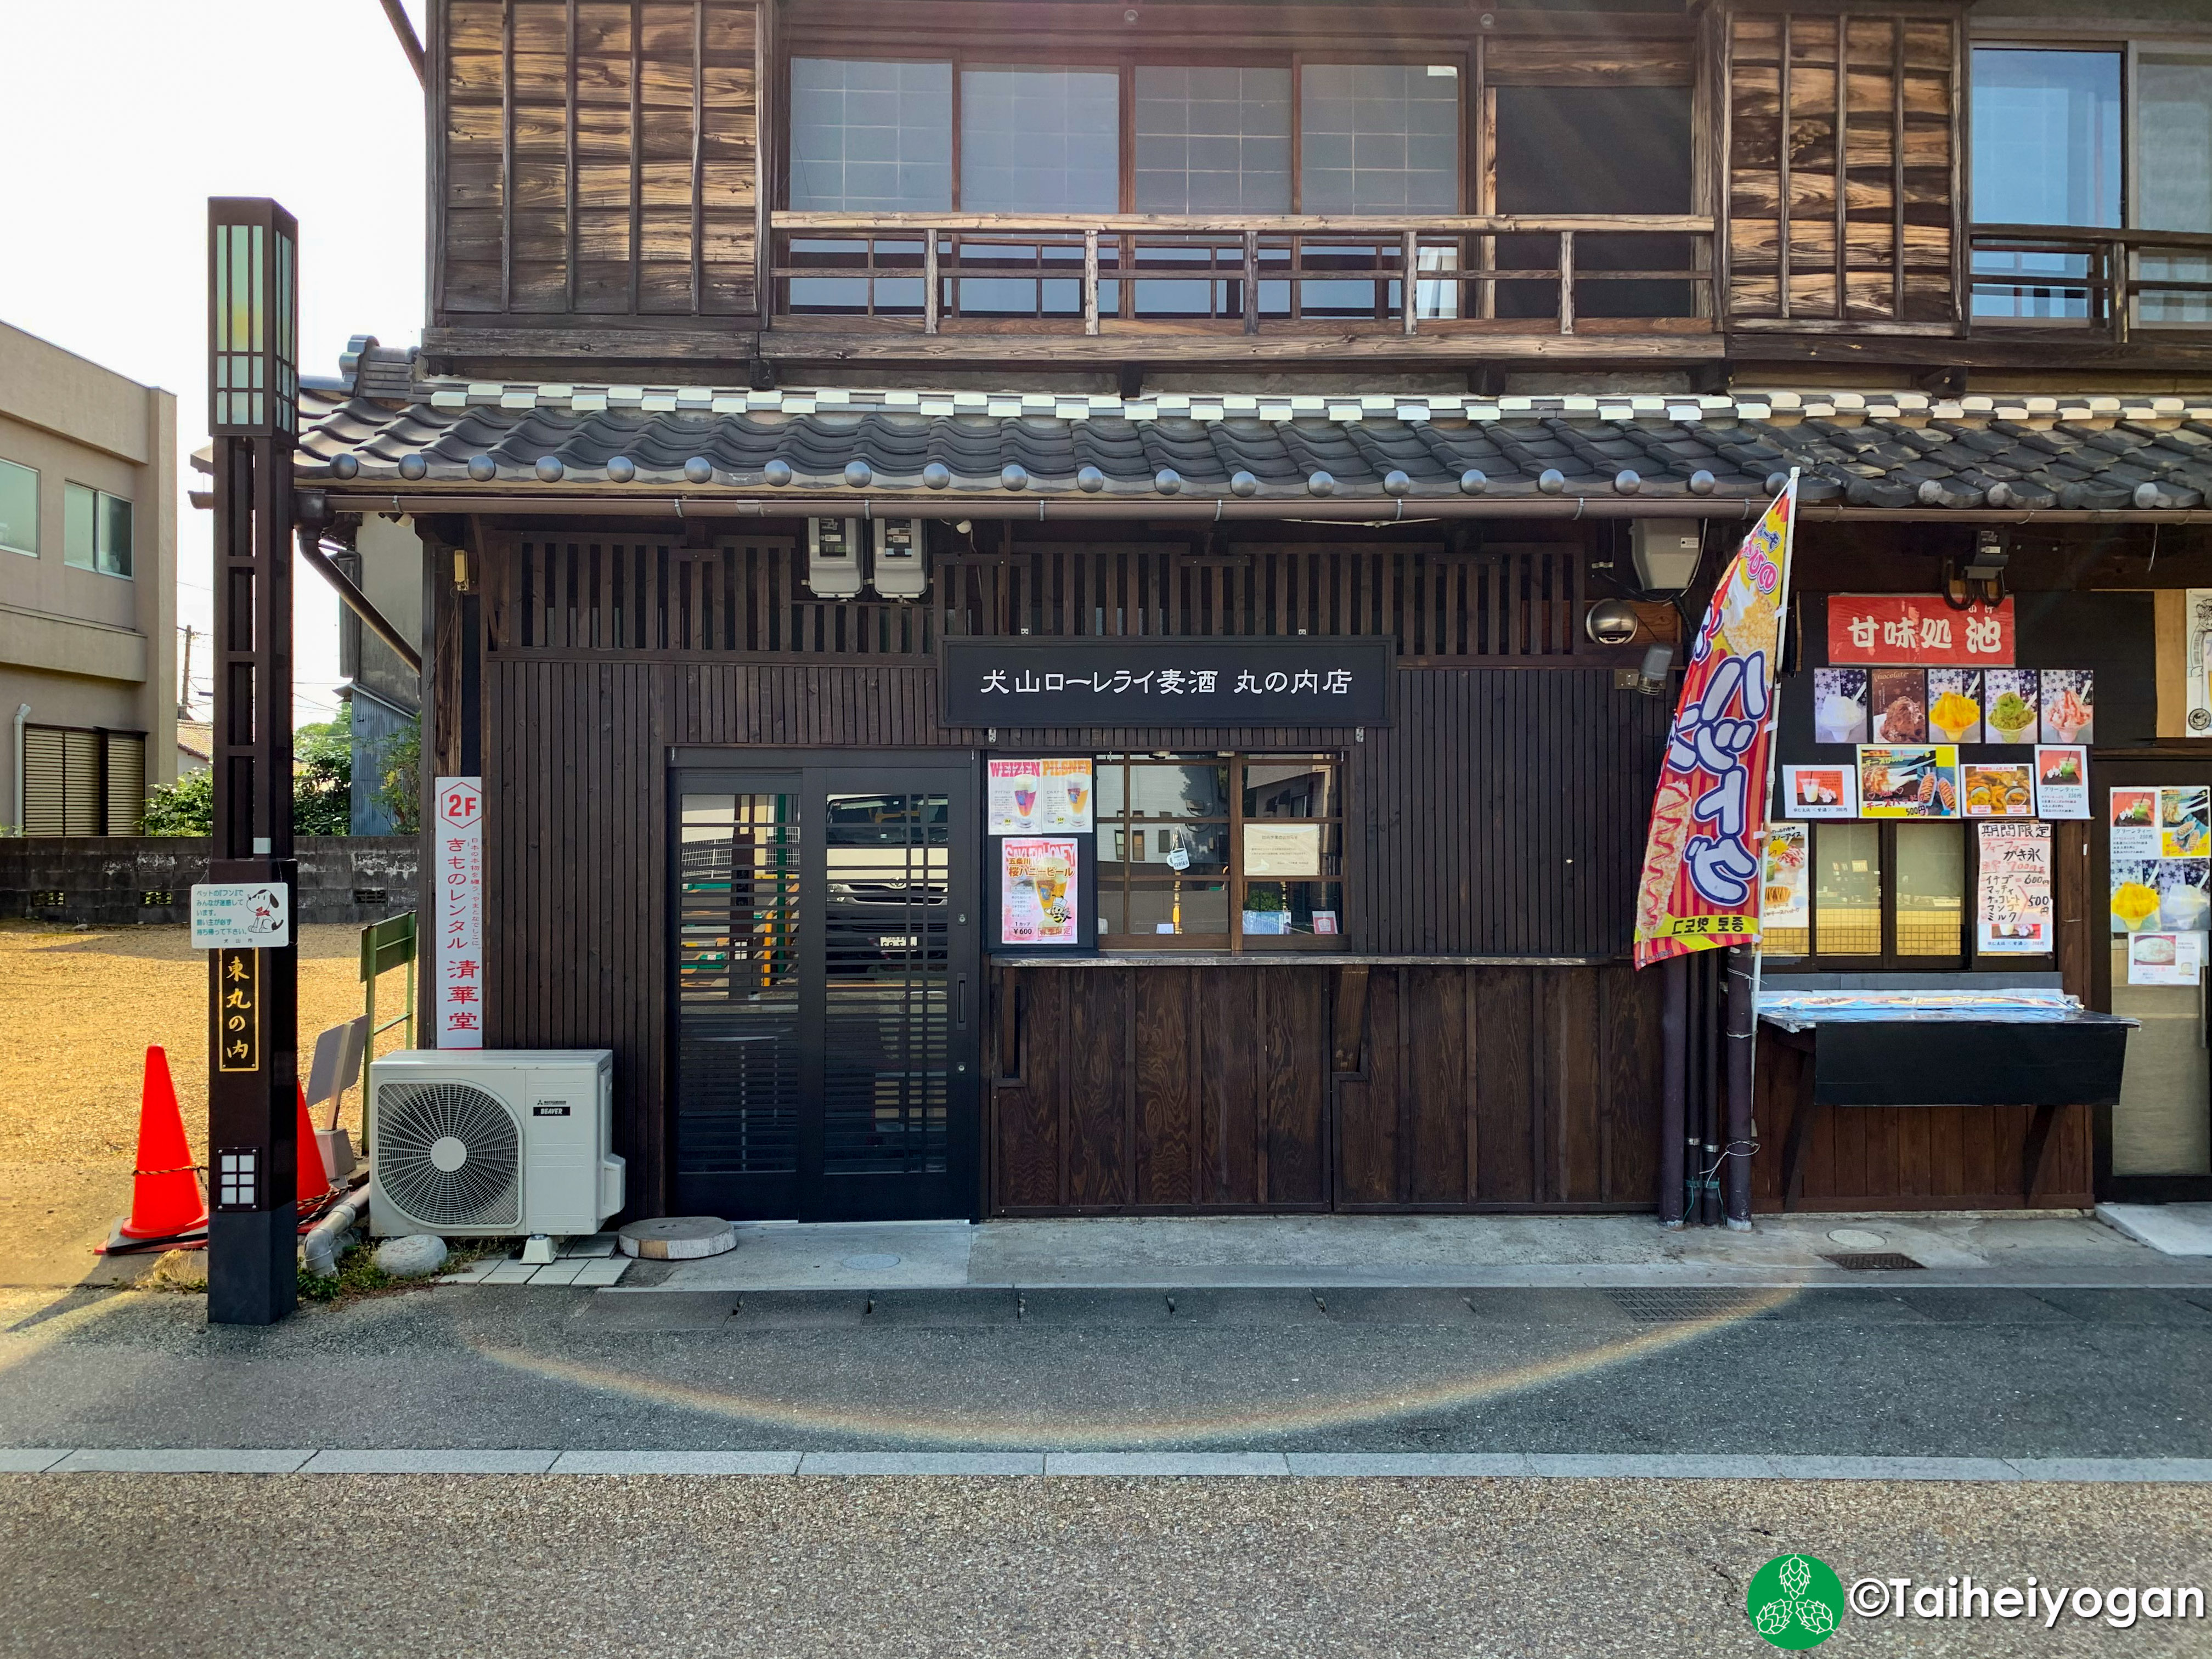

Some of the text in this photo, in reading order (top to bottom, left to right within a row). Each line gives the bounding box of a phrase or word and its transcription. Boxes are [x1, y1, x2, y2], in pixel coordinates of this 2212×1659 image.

[1847, 615, 2002, 653] 甘味処 池
[980, 668, 1353, 696] 犬山ローレライ麦酒 丸の内店
[990, 761, 1041, 777] WEIZEN
[1042, 760, 1093, 776] PILSNER
[448, 794, 477, 817] 2F
[1981, 824, 2051, 838] 期間限定
[1008, 866, 1075, 878] 桜ハニービール
[1987, 912, 2017, 923] ミルク
[447, 838, 480, 1031] きものレンタル 清華堂
[225, 955, 252, 1059] 東丸の内
